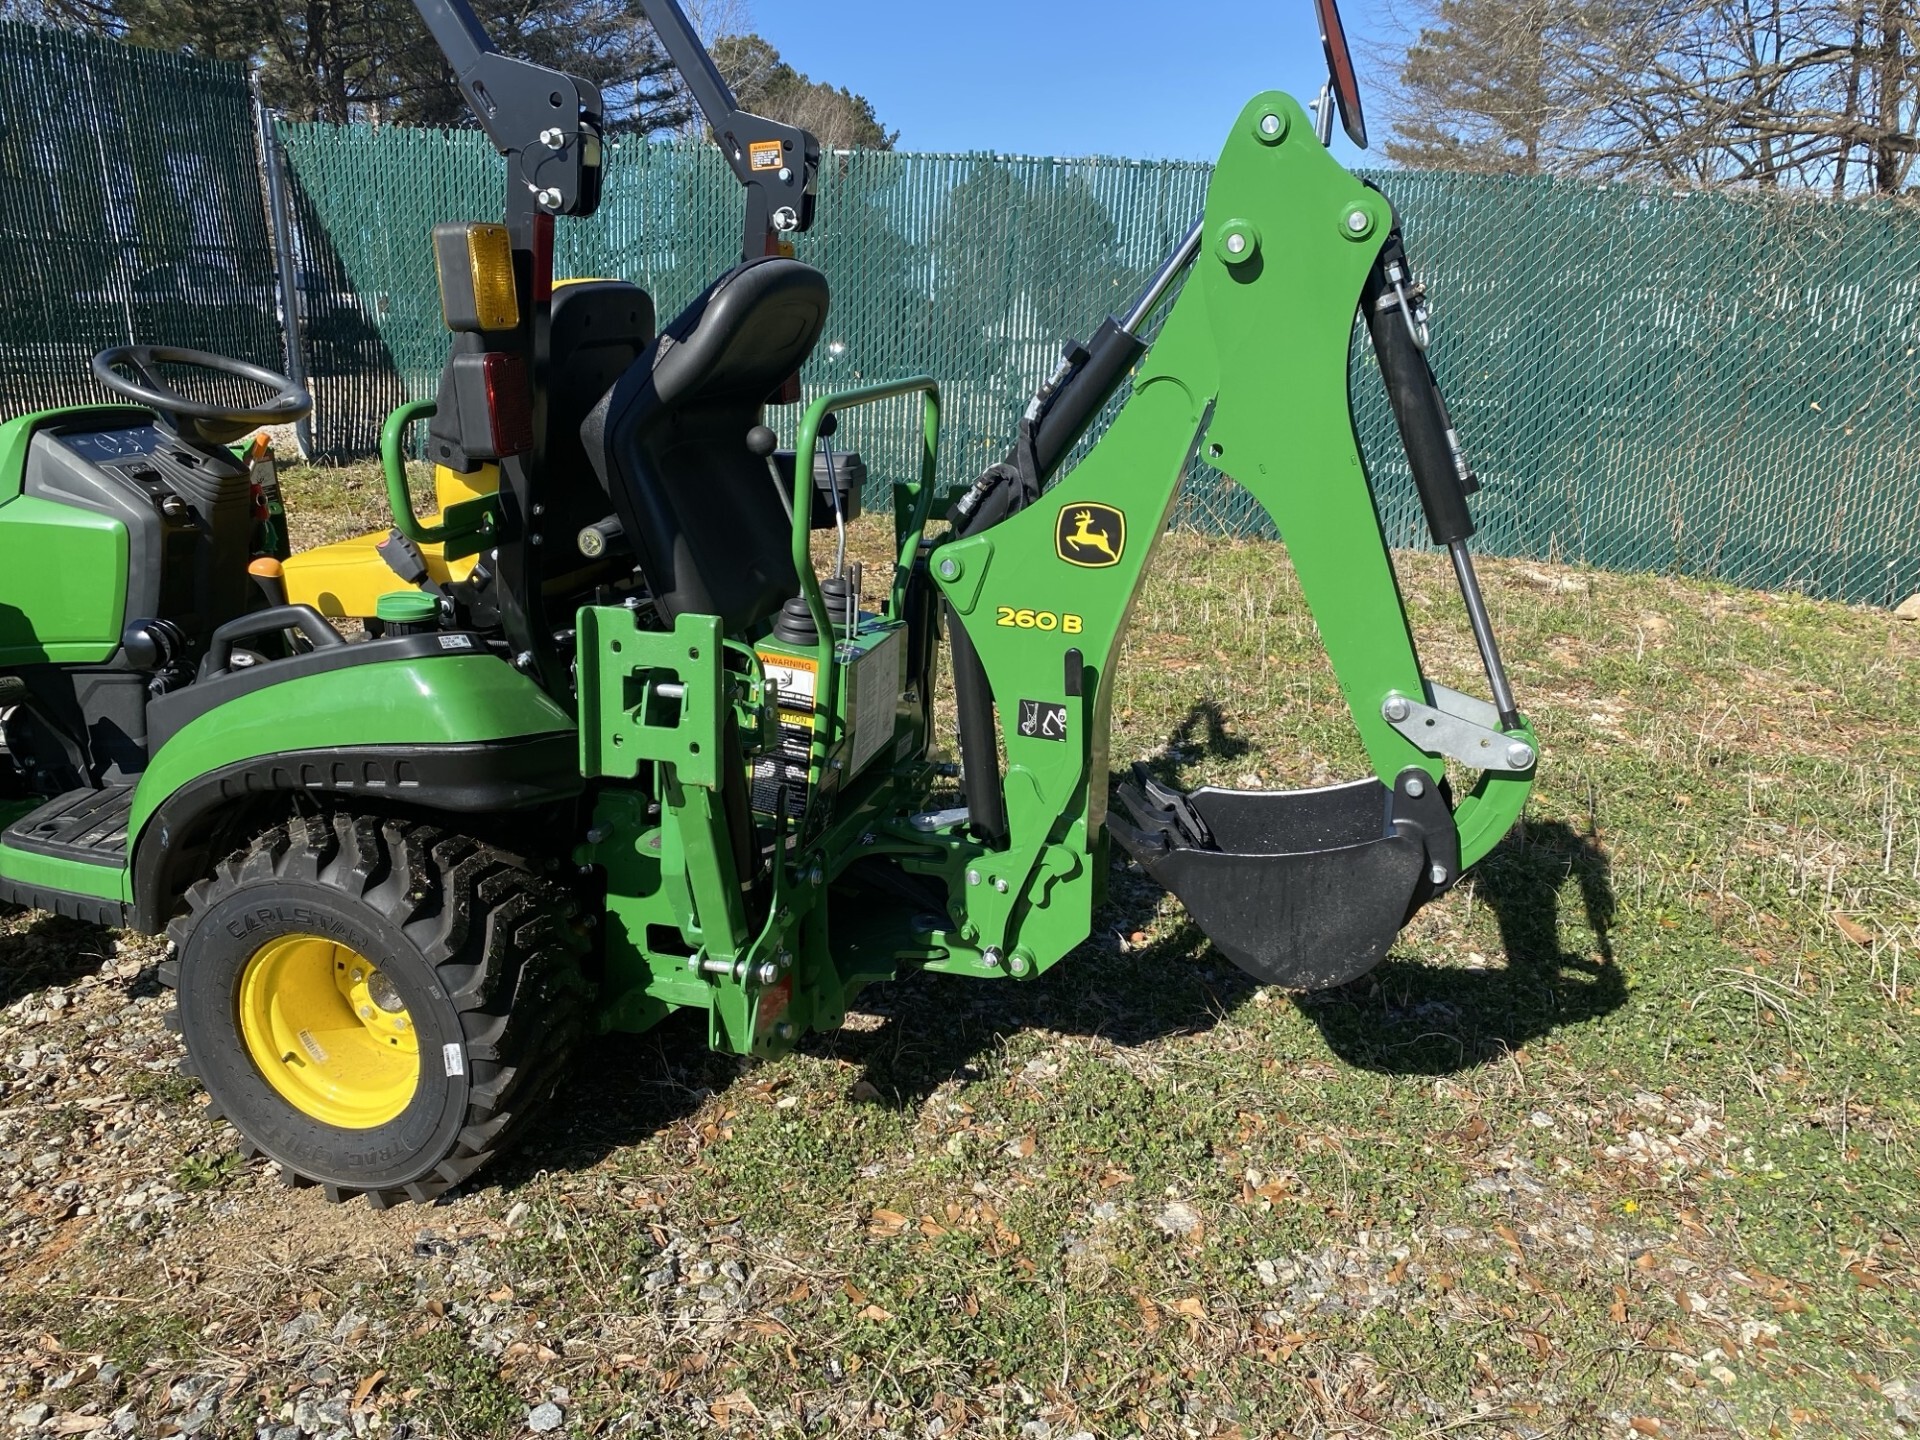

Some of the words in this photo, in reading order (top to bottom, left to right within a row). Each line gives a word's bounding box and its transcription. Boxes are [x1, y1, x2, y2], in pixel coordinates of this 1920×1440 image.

[996, 606, 1058, 632] 260
[1061, 613, 1084, 635] B
[770, 656, 811, 670] WARNING
[780, 713, 807, 725] UTION
[226, 905, 368, 951] CARLSTAR
[347, 1140, 404, 1168] TRAC
